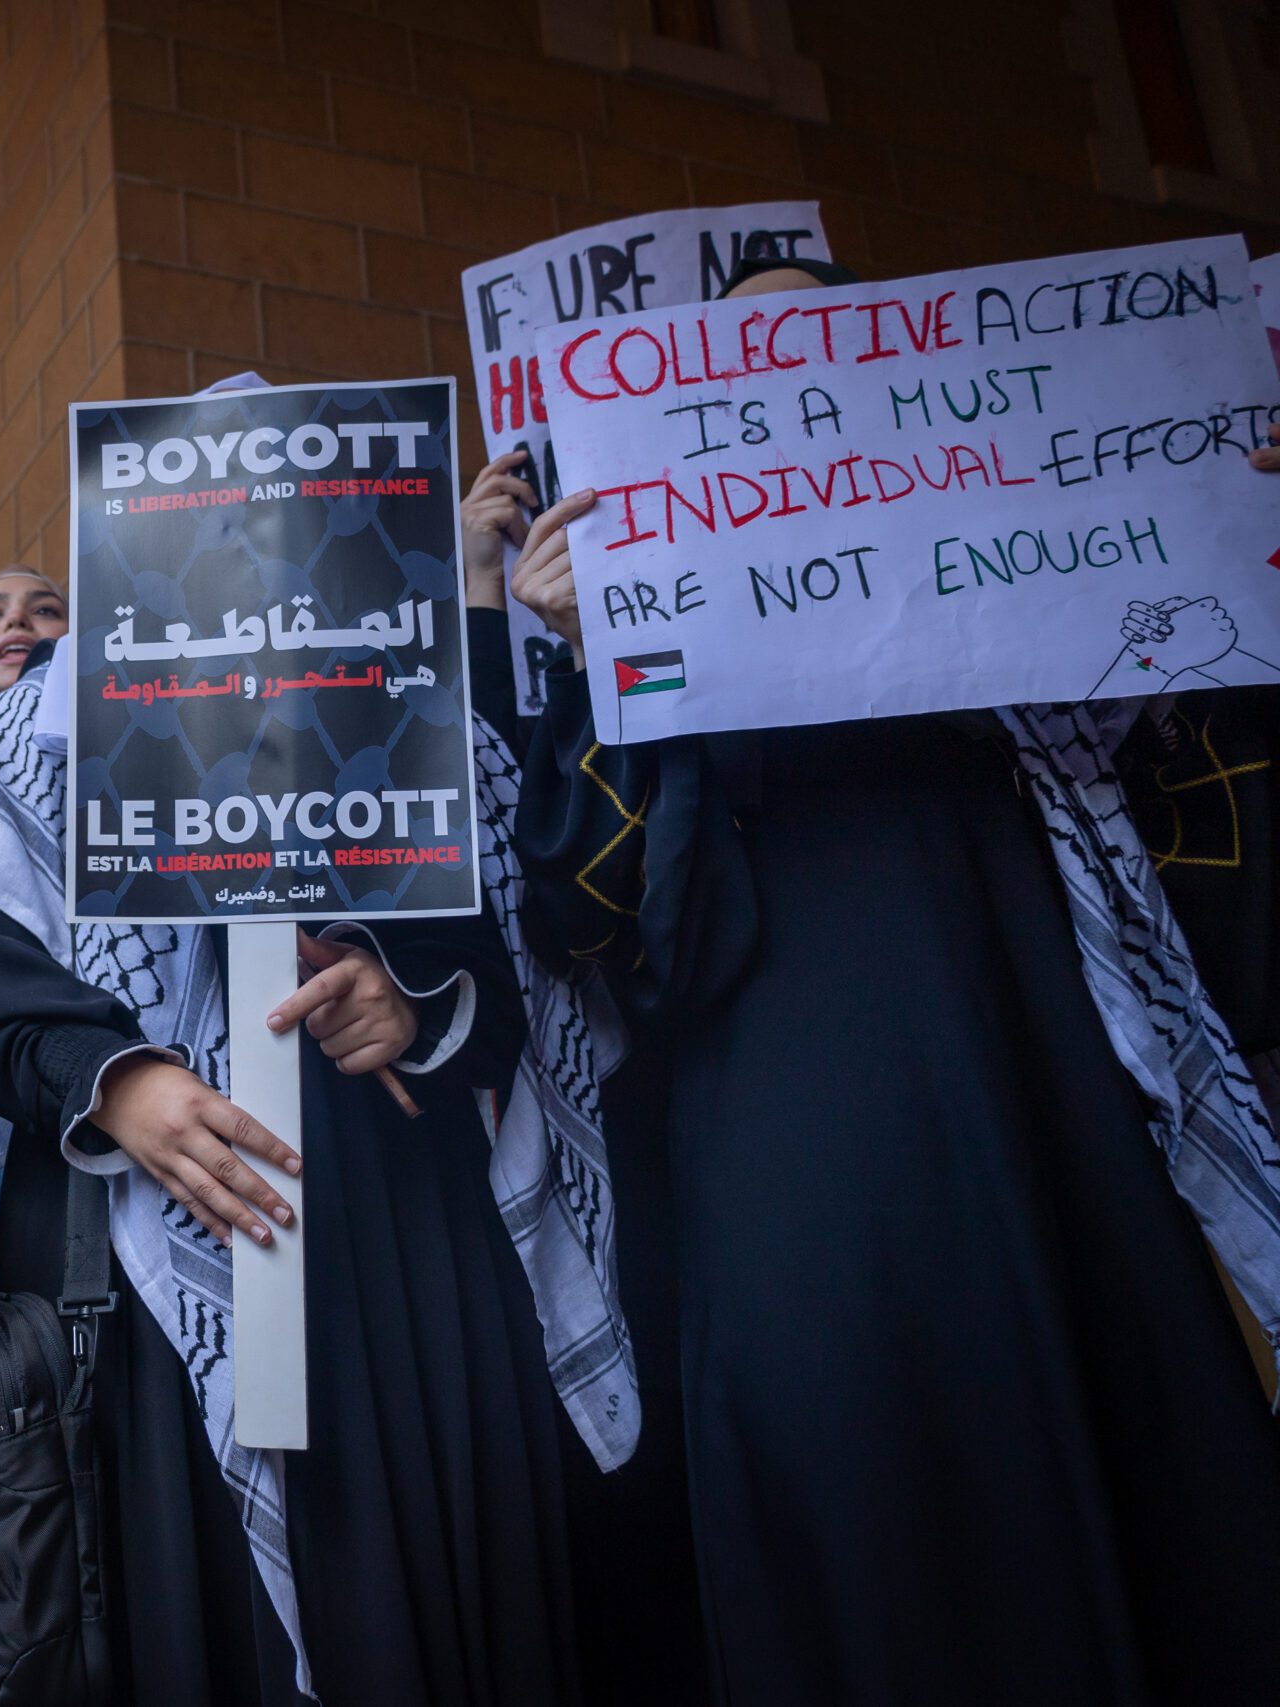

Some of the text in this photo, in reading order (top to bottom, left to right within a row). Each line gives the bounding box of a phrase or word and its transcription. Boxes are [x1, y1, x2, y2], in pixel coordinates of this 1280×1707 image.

[478, 272, 514, 353] IF
[560, 266, 1217, 400] COLLECTIVE ACTION
[664, 365, 1051, 459] IS A MUST
[101, 421, 429, 490] BOYCOTT
[105, 478, 429, 516] IS LIBERATION AND RESISTANCE
[596, 440, 1035, 550] INDIVIDUAL
[603, 517, 1168, 628] ARE NOT ENOUGH
[104, 594, 434, 662] المقاطعة
[260, 664, 383, 699] التحرر
[385, 664, 436, 699] هي
[86, 788, 459, 846] LE BOYCOTT
[87, 846, 460, 873] EST LA LIBÉRATION ET LA RÉSISTANCE
